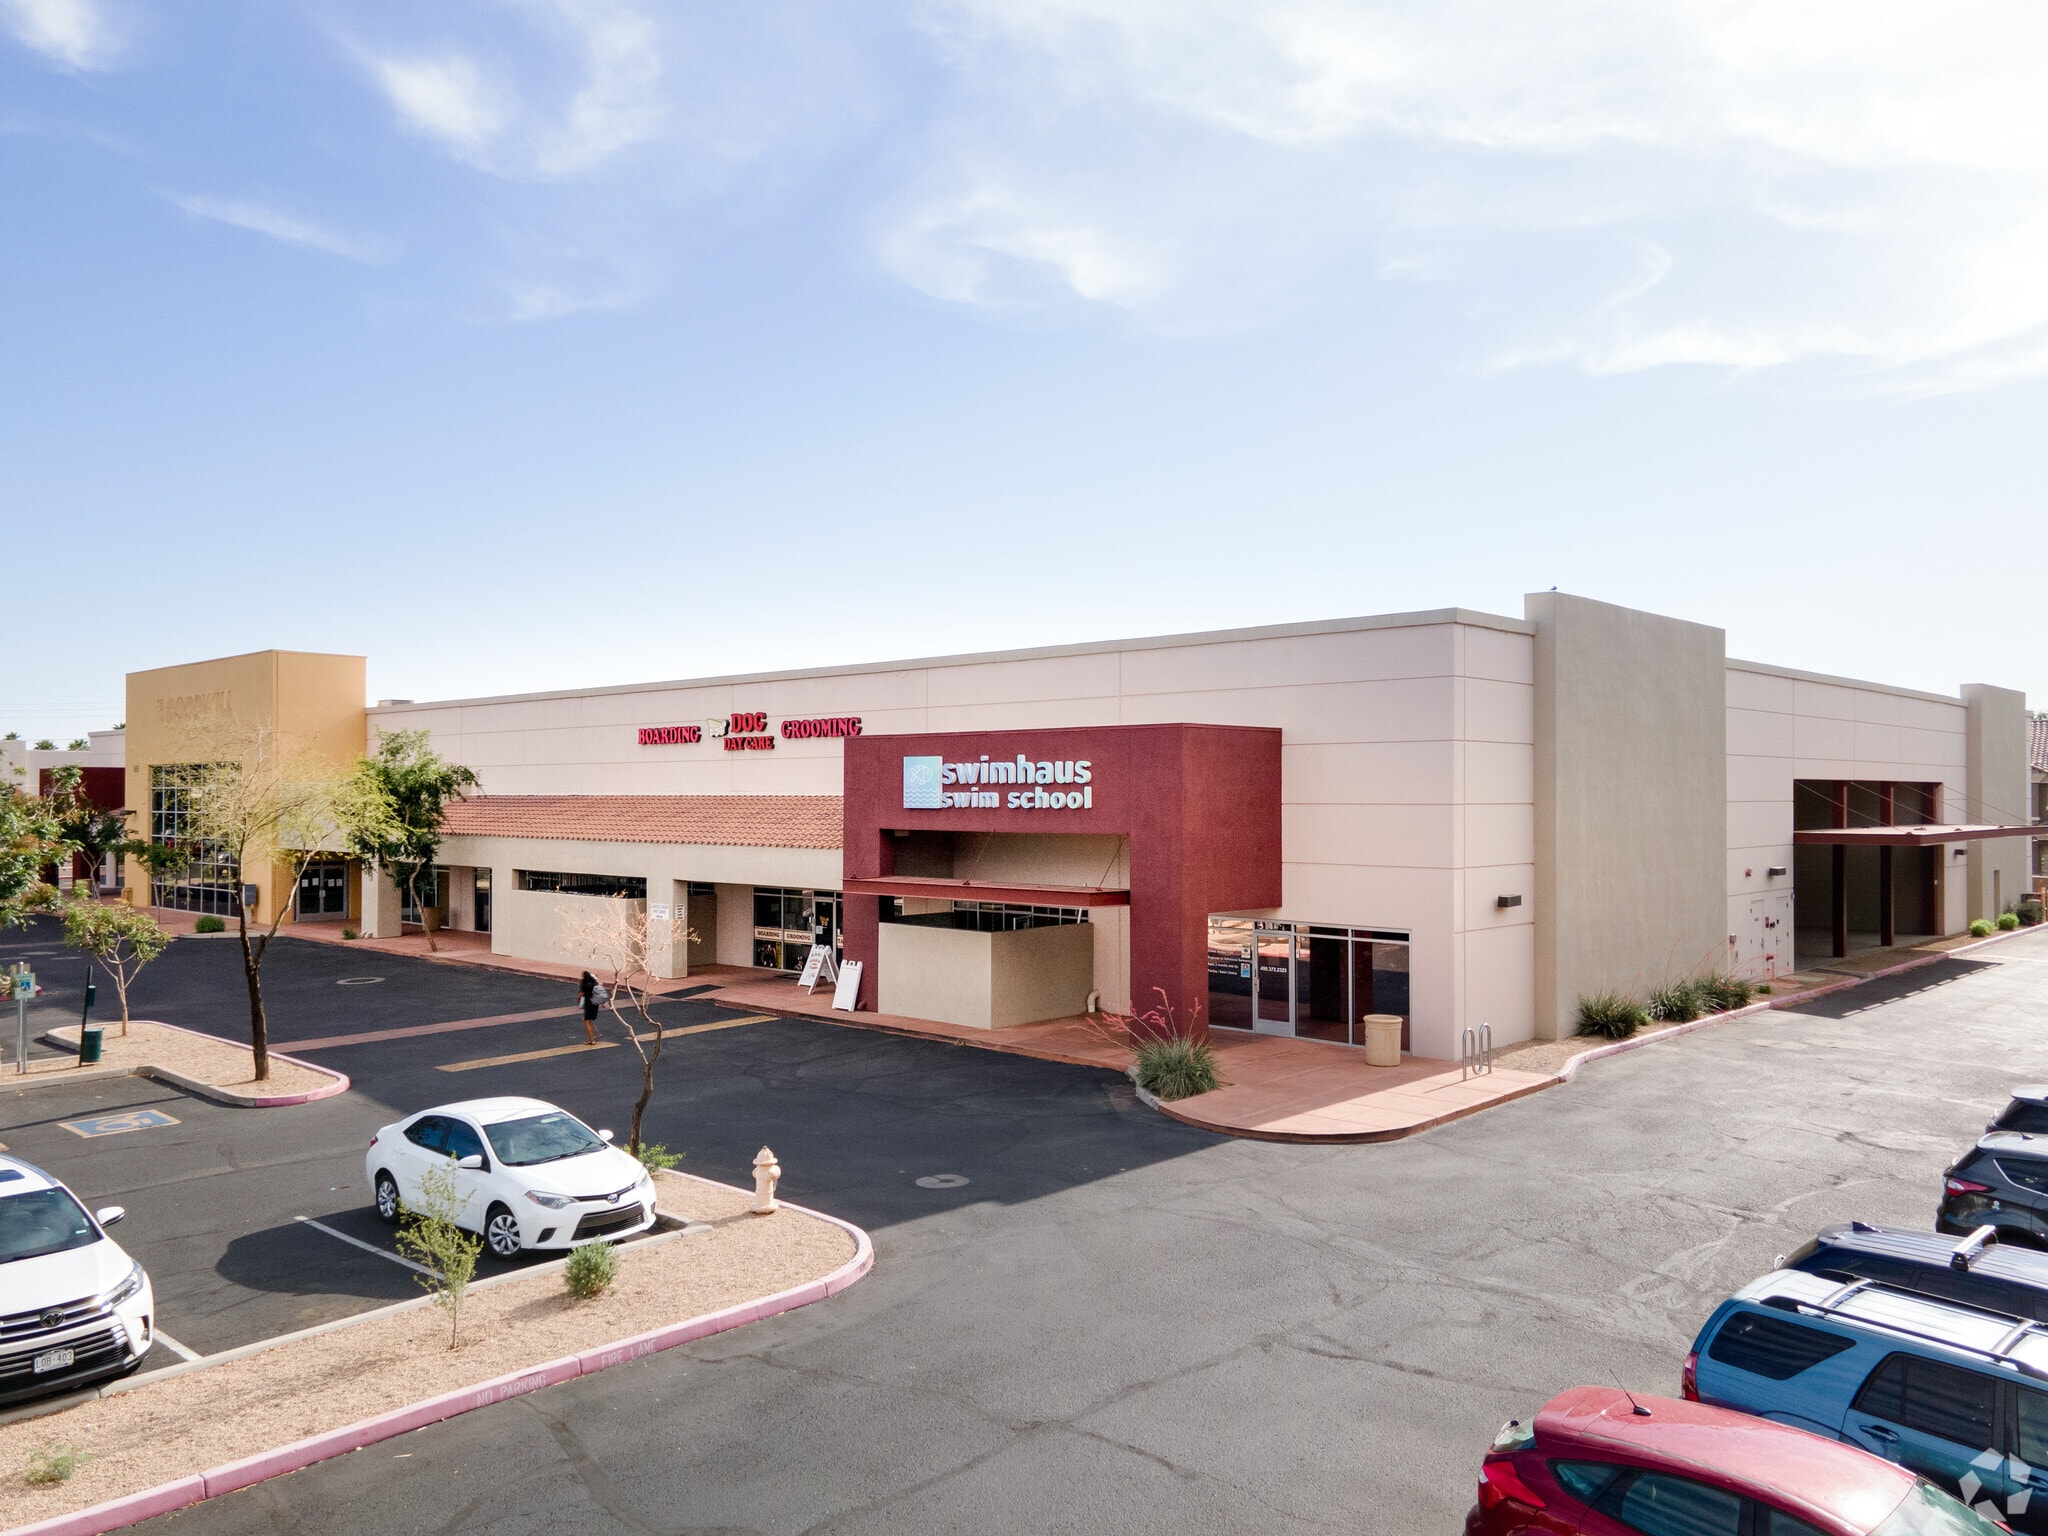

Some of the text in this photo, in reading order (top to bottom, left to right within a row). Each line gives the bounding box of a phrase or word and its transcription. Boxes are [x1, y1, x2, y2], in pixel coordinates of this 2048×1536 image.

[731, 712, 767, 733] DOG
[780, 717, 863, 739] GROOMING
[638, 726, 702, 745] BOARDING
[724, 735, 775, 751] DAY CARE
[941, 754, 1092, 785] swimhaus
[941, 786, 1093, 809] swim school
[757, 930, 780, 938] BOARDING
[786, 933, 811, 941] GROOMING
[601, 1339, 657, 1369] FIRE LANE
[476, 1374, 546, 1406] NO PARKING
